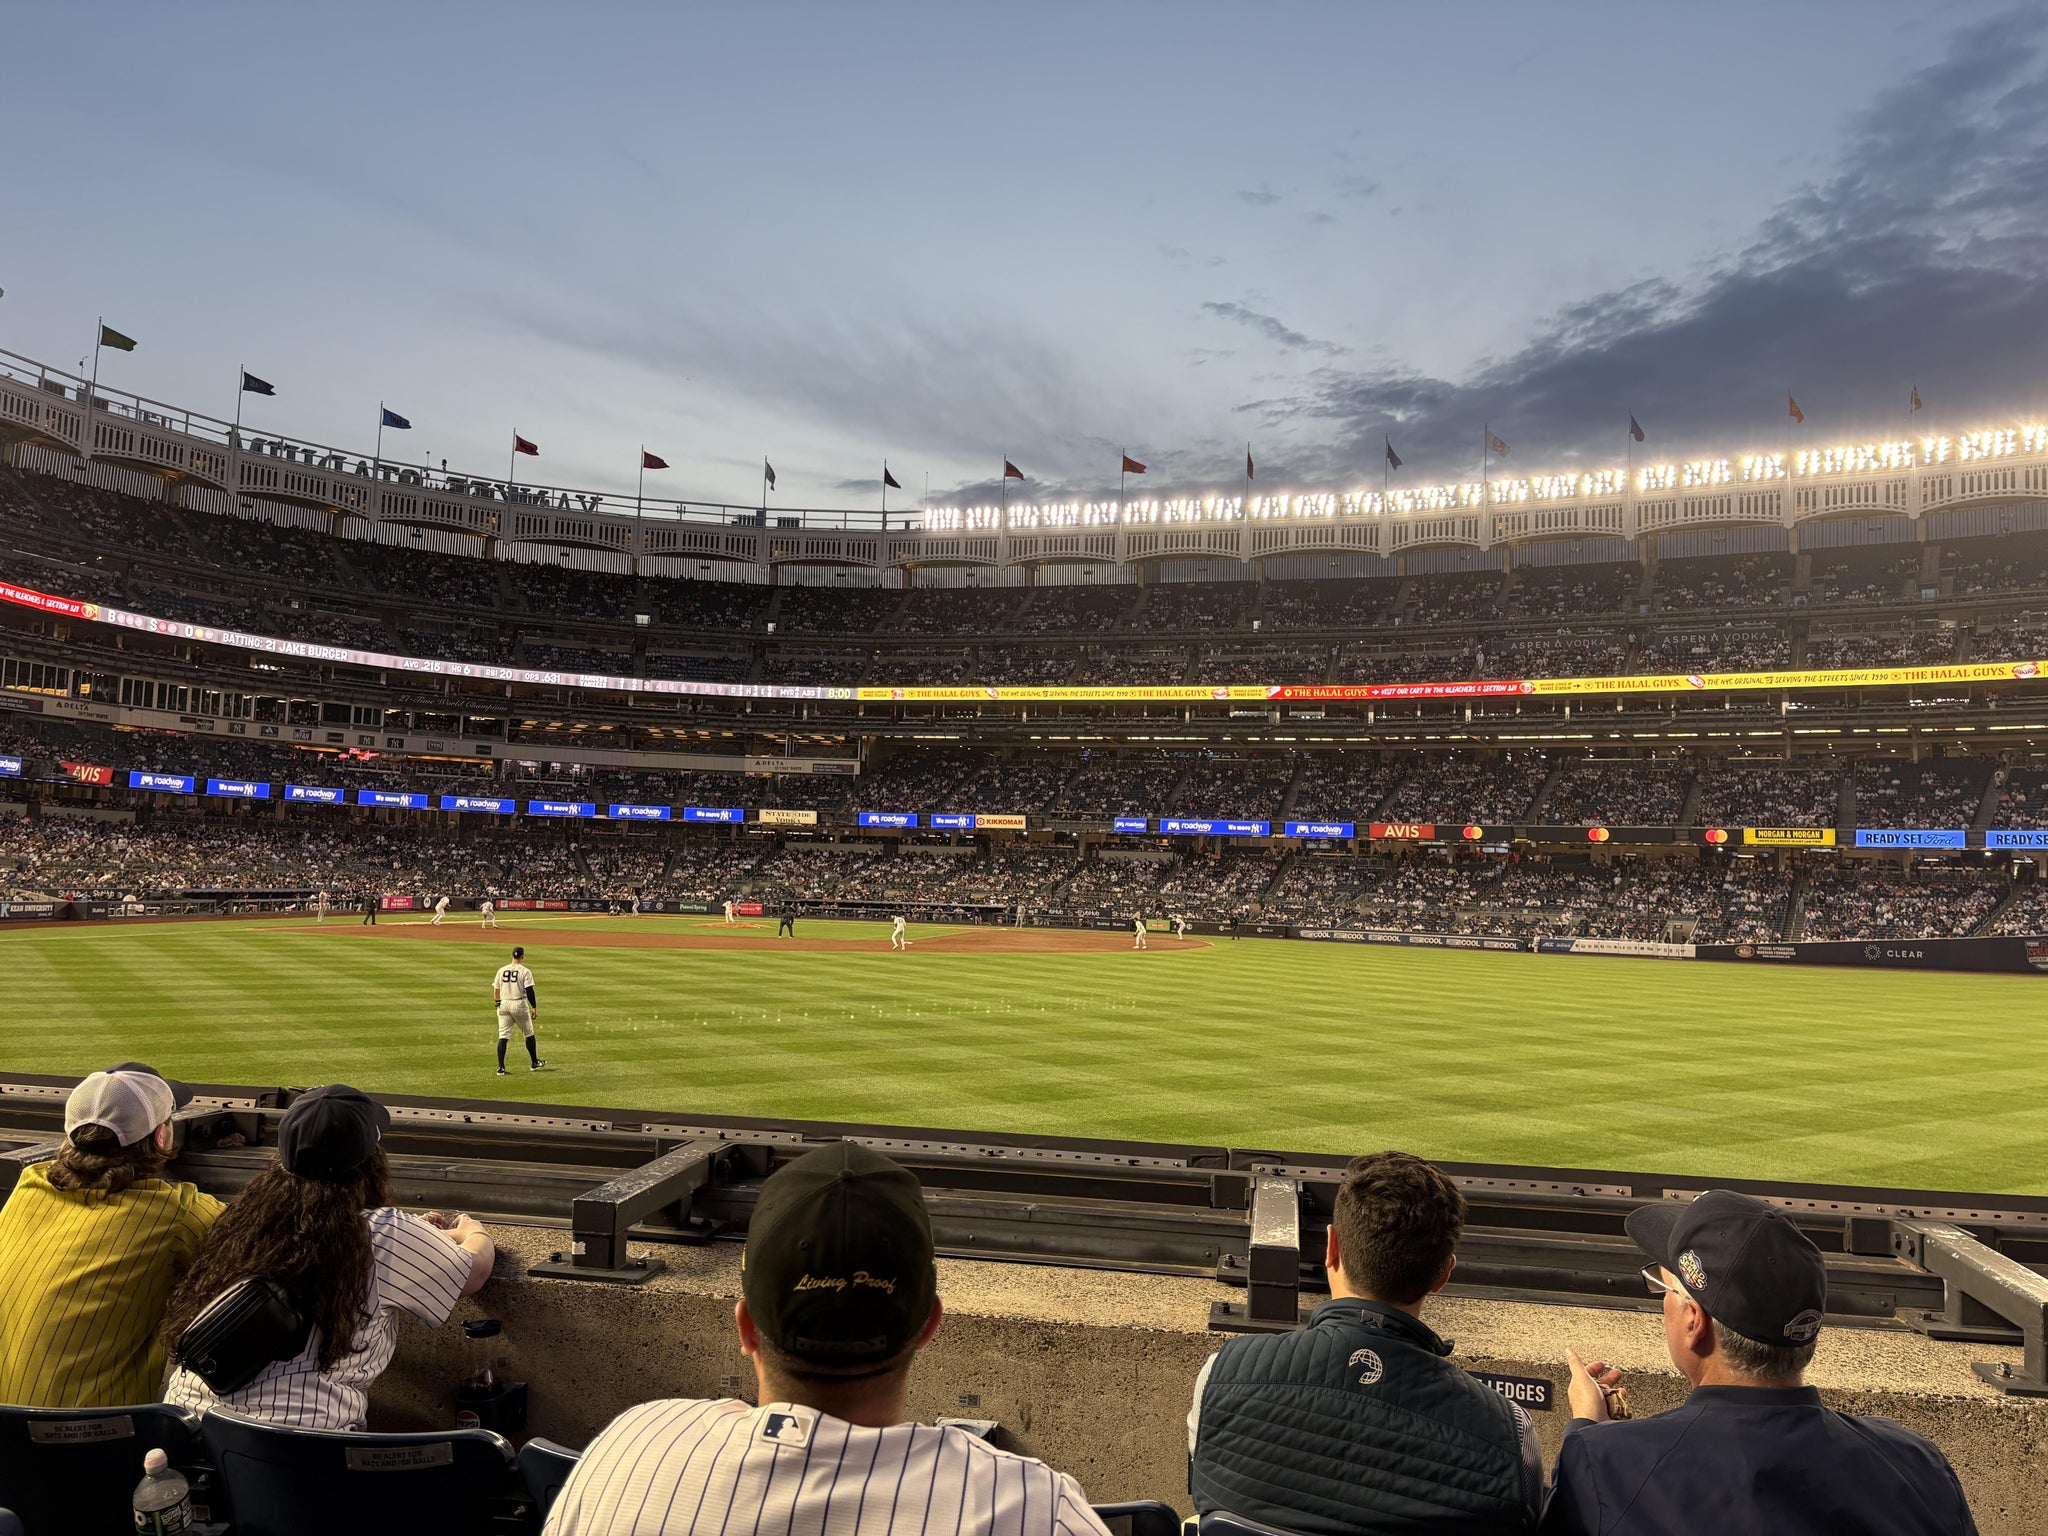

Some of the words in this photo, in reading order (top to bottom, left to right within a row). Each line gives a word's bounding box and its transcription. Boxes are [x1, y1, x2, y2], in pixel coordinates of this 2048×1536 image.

[46, 599, 69, 611] SECTION
[108, 609, 116, 622] B
[150, 618, 158, 631] S
[1663, 635, 1706, 645] ASPEN
[1723, 631, 1768, 643] VODKA
[222, 632, 263, 649] BATTING:
[265, 639, 277, 651] 21
[279, 643, 306, 655] JAKE
[307, 646, 348, 661] BURGER
[1511, 642, 1550, 650] ASPEN
[1566, 639, 1607, 649] VODKA
[403, 660, 419, 669] AVG
[421, 660, 441, 672] .215
[452, 664, 462, 674] HR
[463, 665, 471, 675] 6
[485, 668, 498, 677] RBI
[500, 669, 513, 680] 20
[541, 673, 561, 683] .631
[1902, 671, 1927, 680] THE
[1930, 669, 1970, 679] HALAL
[1775, 675, 1802, 683] SERVING
[1818, 674, 1848, 682] STREETS
[1850, 674, 1869, 682] SINCE
[1871, 673, 1889, 681] 1990
[1410, 686, 1424, 695] CART
[1483, 683, 1507, 692] SECTION
[1595, 681, 1616, 689] THE
[1618, 680, 1651, 689] HALAL
[828, 688, 851, 699] 8:00
[916, 690, 931, 698] THE
[933, 690, 957, 698] HALAL
[1156, 690, 1182, 698] HALAL
[1293, 688, 1310, 697] THE
[1313, 688, 1342, 697] HALAL
[64, 703, 89, 711] DELTA
[73, 766, 100, 782] AVIS
[155, 777, 184, 788] roadway
[306, 789, 336, 799] roadway
[470, 800, 500, 809] roadway
[632, 808, 661, 817] roadway
[880, 815, 908, 824] roadway
[1181, 822, 1212, 831] roadway
[1310, 826, 1343, 835] roadway
[1384, 825, 1420, 837] AVIS
[1758, 830, 1785, 838] MORGAN
[1865, 833, 1900, 844] READY
[1904, 833, 1922, 844] SET
[1923, 832, 1956, 846] Ford
[1996, 834, 2032, 845] READY
[24, 904, 53, 912] UNIVERSITY
[1382, 934, 1400, 942] COOL
[1461, 939, 1480, 947] COOL
[1499, 941, 1518, 949] COOL
[1887, 950, 1923, 959] CLEAR
[502, 970, 519, 983] 99
[793, 1274, 847, 1292] Living
[853, 1271, 897, 1294] Proof
[94, 1429, 117, 1437] BALLS
[382, 1458, 411, 1468] AND/OR
[413, 1456, 436, 1464] BALLS
